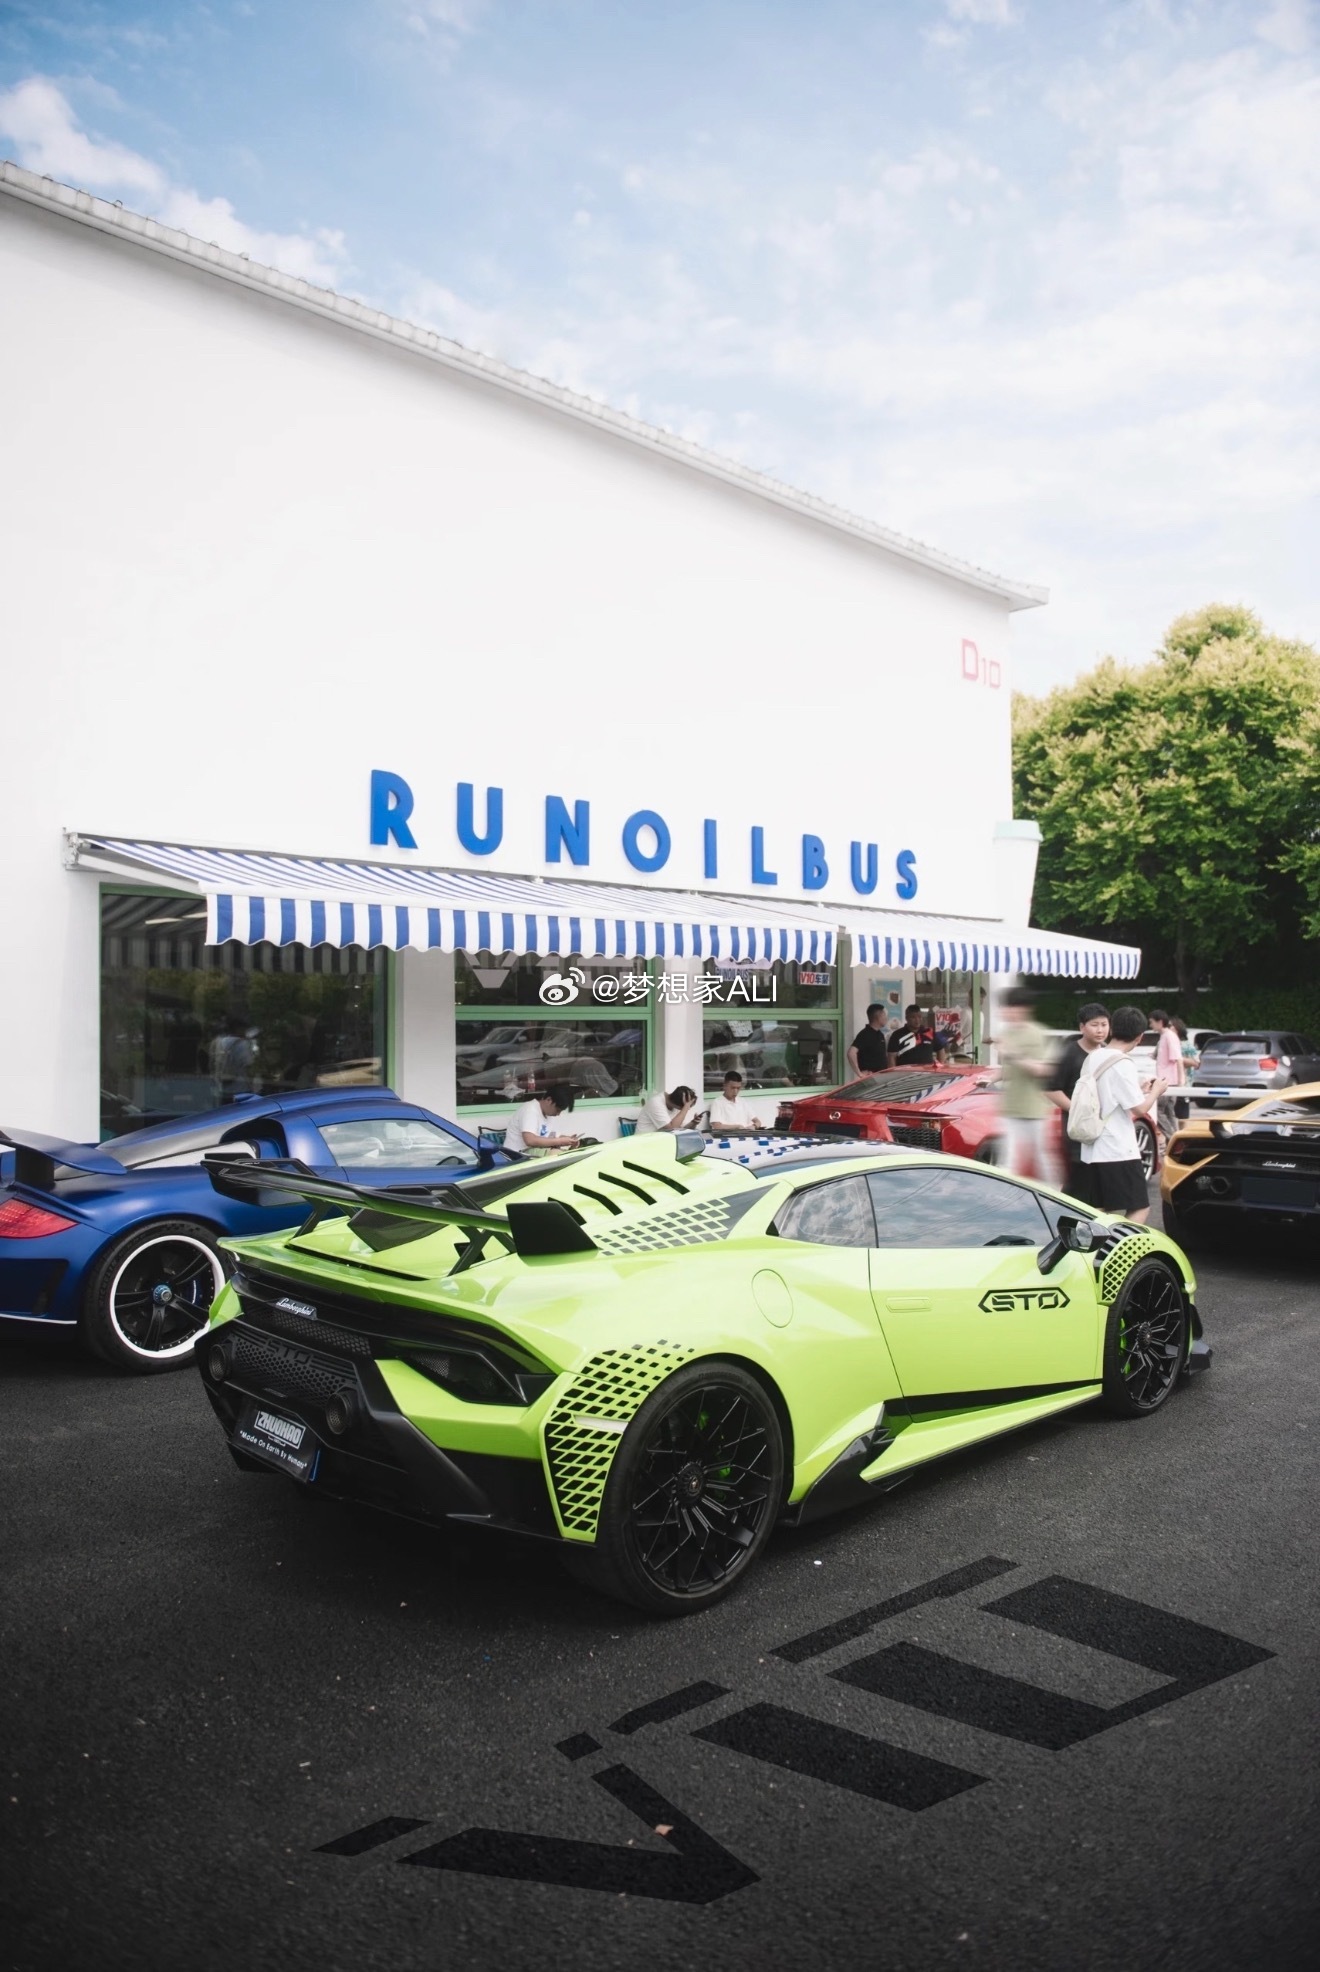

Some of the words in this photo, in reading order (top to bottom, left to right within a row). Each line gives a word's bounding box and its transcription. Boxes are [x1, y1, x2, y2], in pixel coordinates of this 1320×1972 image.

[962, 638, 1001, 689] D10
[369, 769, 919, 900] RUNOILBUS
[276, 1298, 315, 1315] Lamborghini
[991, 1293, 1059, 1312] STO
